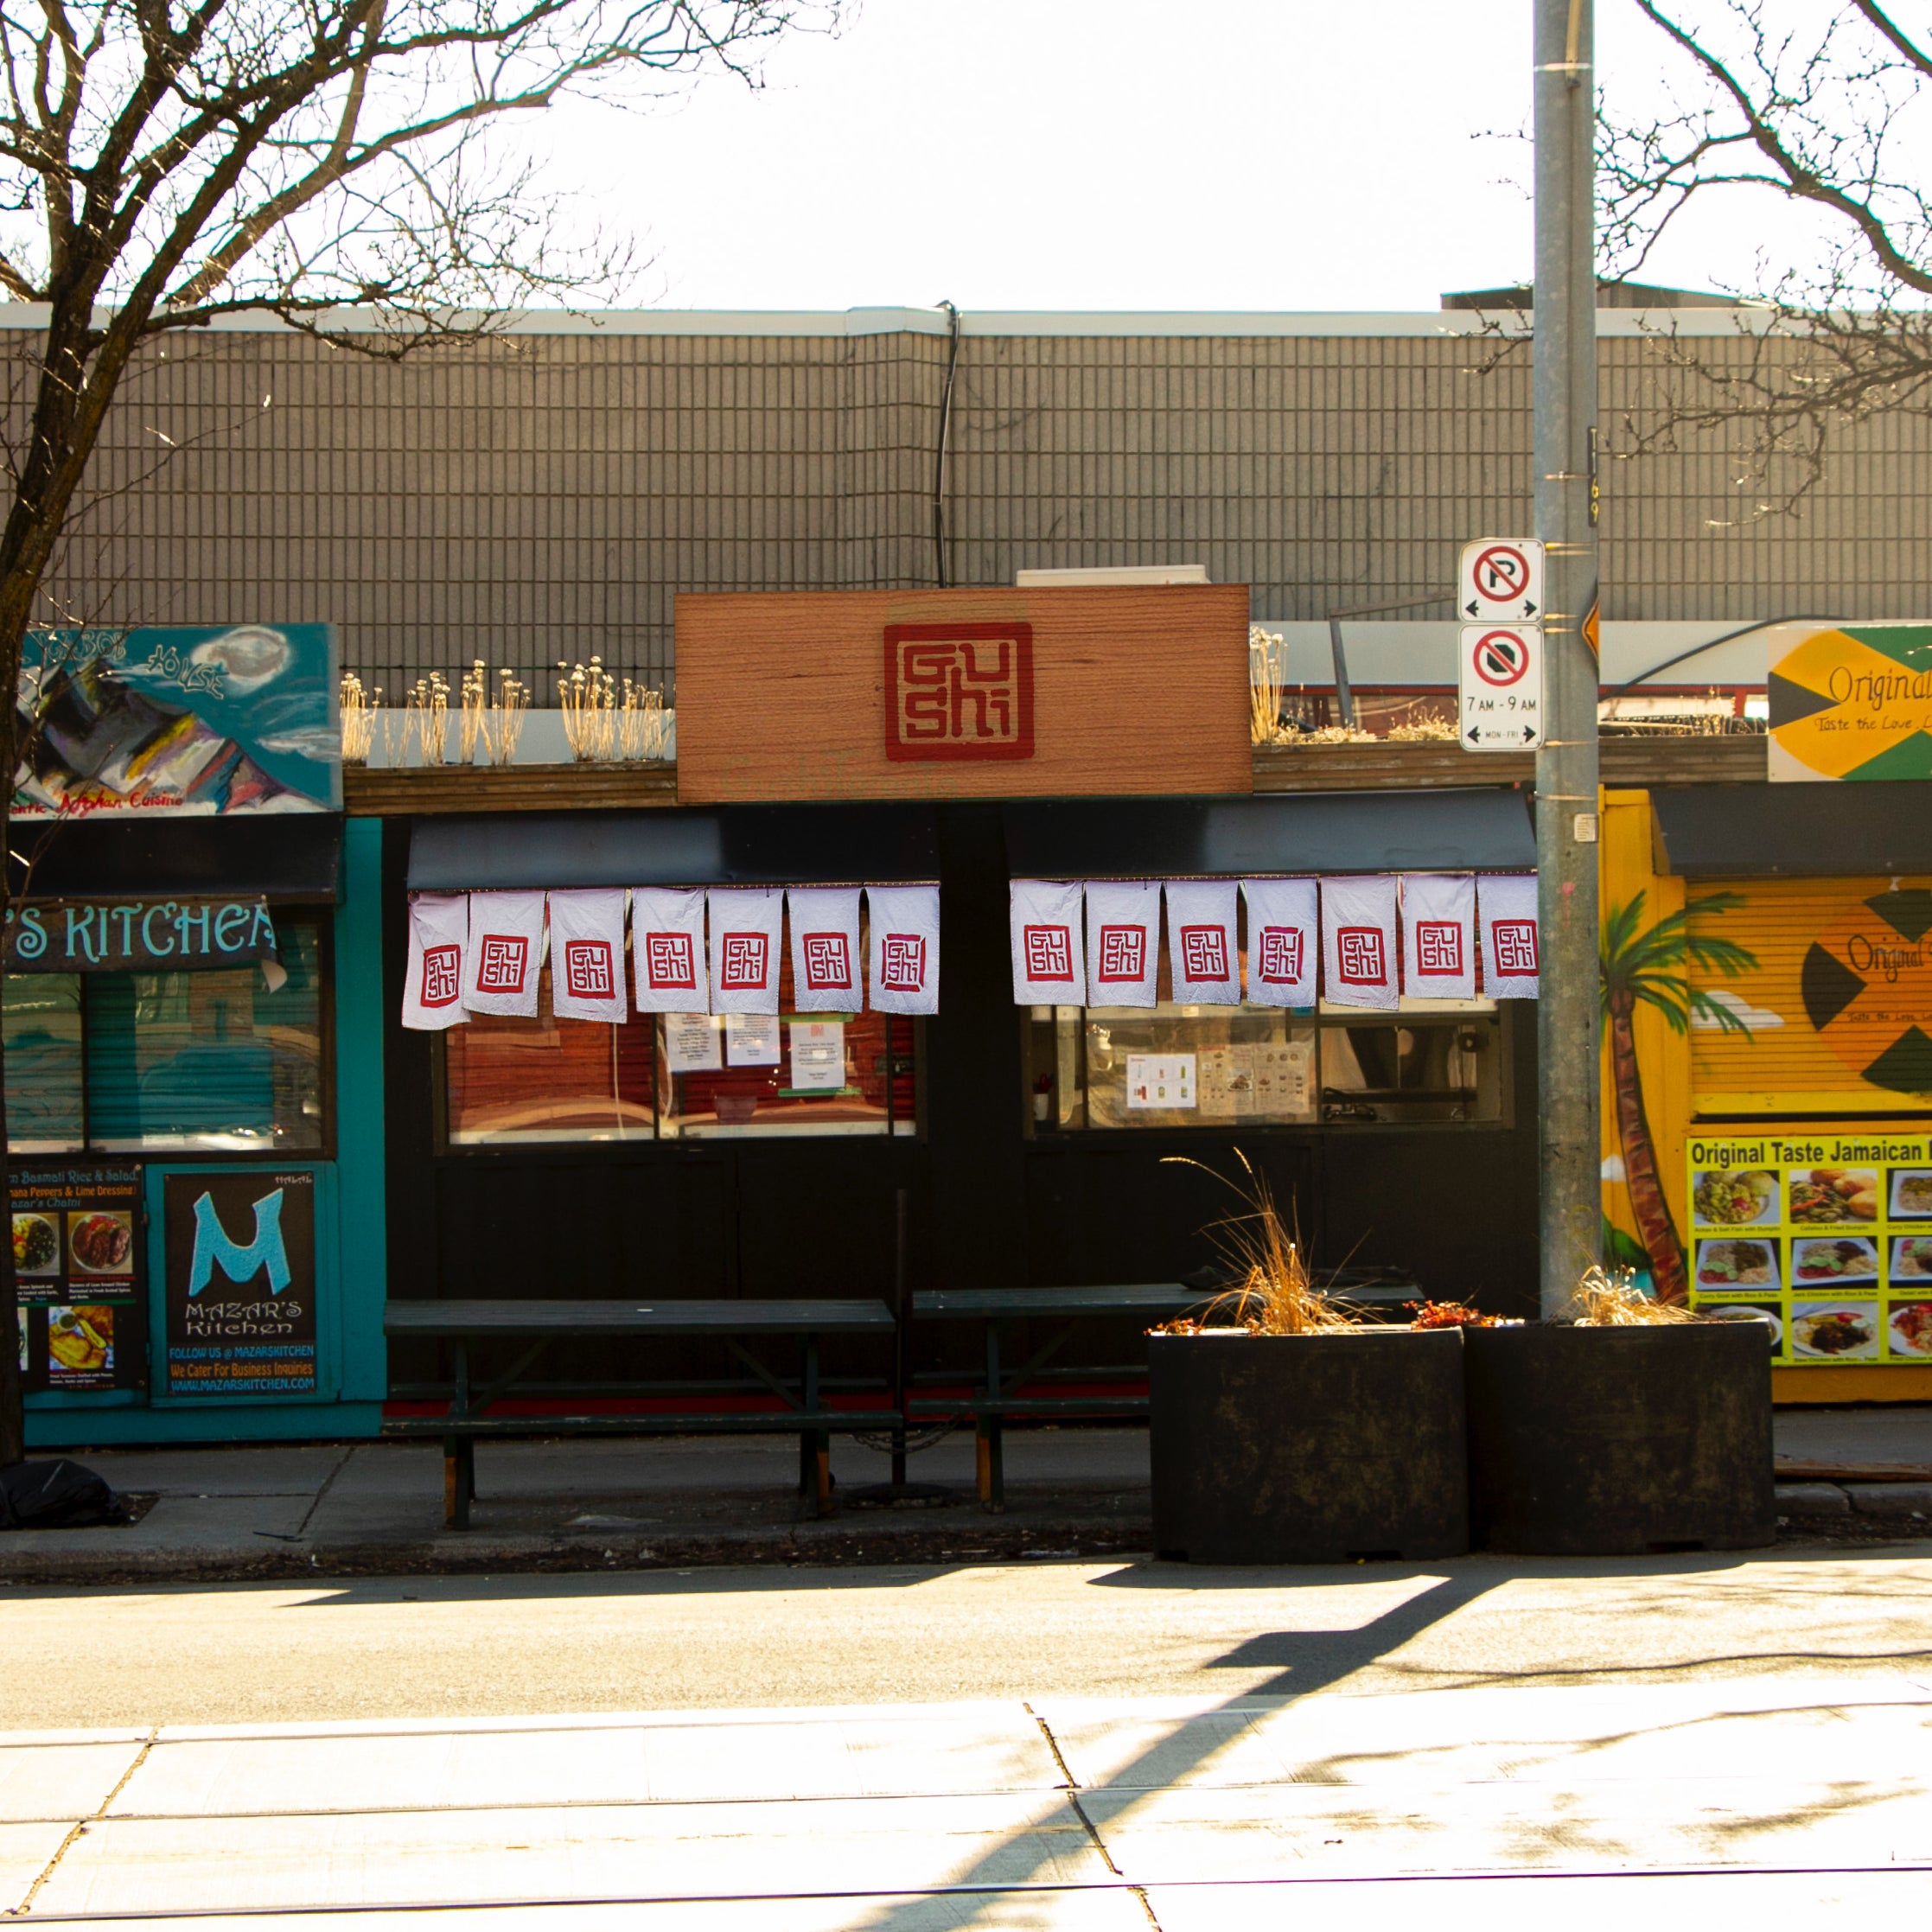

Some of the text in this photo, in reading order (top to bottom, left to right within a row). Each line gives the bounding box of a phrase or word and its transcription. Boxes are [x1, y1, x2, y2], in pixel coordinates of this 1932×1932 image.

[1467, 697, 1475, 711] 7
[1479, 700, 1494, 711] AM
[1508, 696, 1516, 711] 9
[1521, 700, 1536, 711] AM
[1857, 717, 1878, 730] the
[10, 802, 47, 815] entic
[1692, 1142, 1765, 1169] Original
[1771, 1141, 1824, 1164] Taste
[1830, 1140, 1922, 1163] Jamaican
[75, 1186, 95, 1196] Lime
[186, 1301, 302, 1321] MAZAR'S
[187, 1321, 293, 1336] Kitchen
[169, 1345, 314, 1360] FOLLOW US @ MAZARSKITCHEN
[170, 1363, 184, 1377] We
[187, 1363, 212, 1377] Cater
[214, 1362, 229, 1376] For
[232, 1362, 272, 1376] Business
[171, 1378, 315, 1392] WWW.MAZARSKITCHEN.COM
